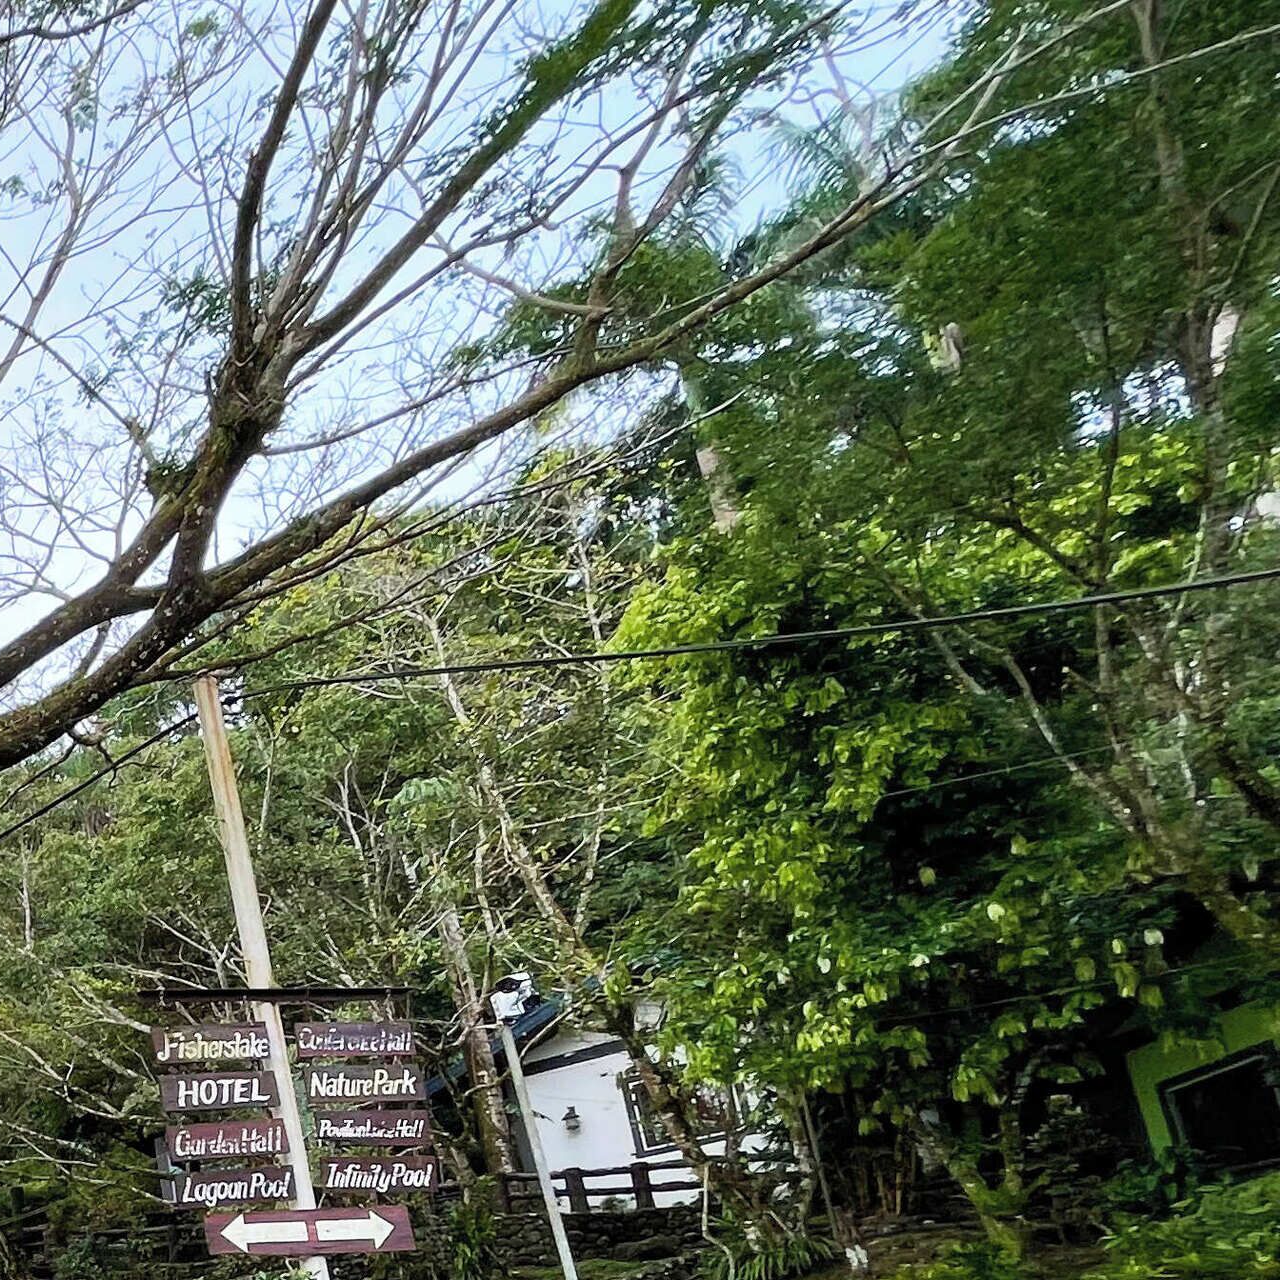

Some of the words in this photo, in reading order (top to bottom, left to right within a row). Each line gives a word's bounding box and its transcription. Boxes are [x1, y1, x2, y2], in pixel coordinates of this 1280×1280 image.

[157, 1032, 268, 1061] Fisherslake
[177, 1078, 271, 1107] HOTEL
[310, 1072, 373, 1097] Nature
[372, 1069, 417, 1095] Park
[175, 1130, 241, 1157] Garden
[241, 1126, 282, 1153] Hall
[395, 1119, 425, 1138] Hall
[182, 1177, 248, 1207] Lagoon
[249, 1172, 291, 1198] Pool
[326, 1163, 391, 1193] Infinity
[391, 1163, 433, 1187] Pool
